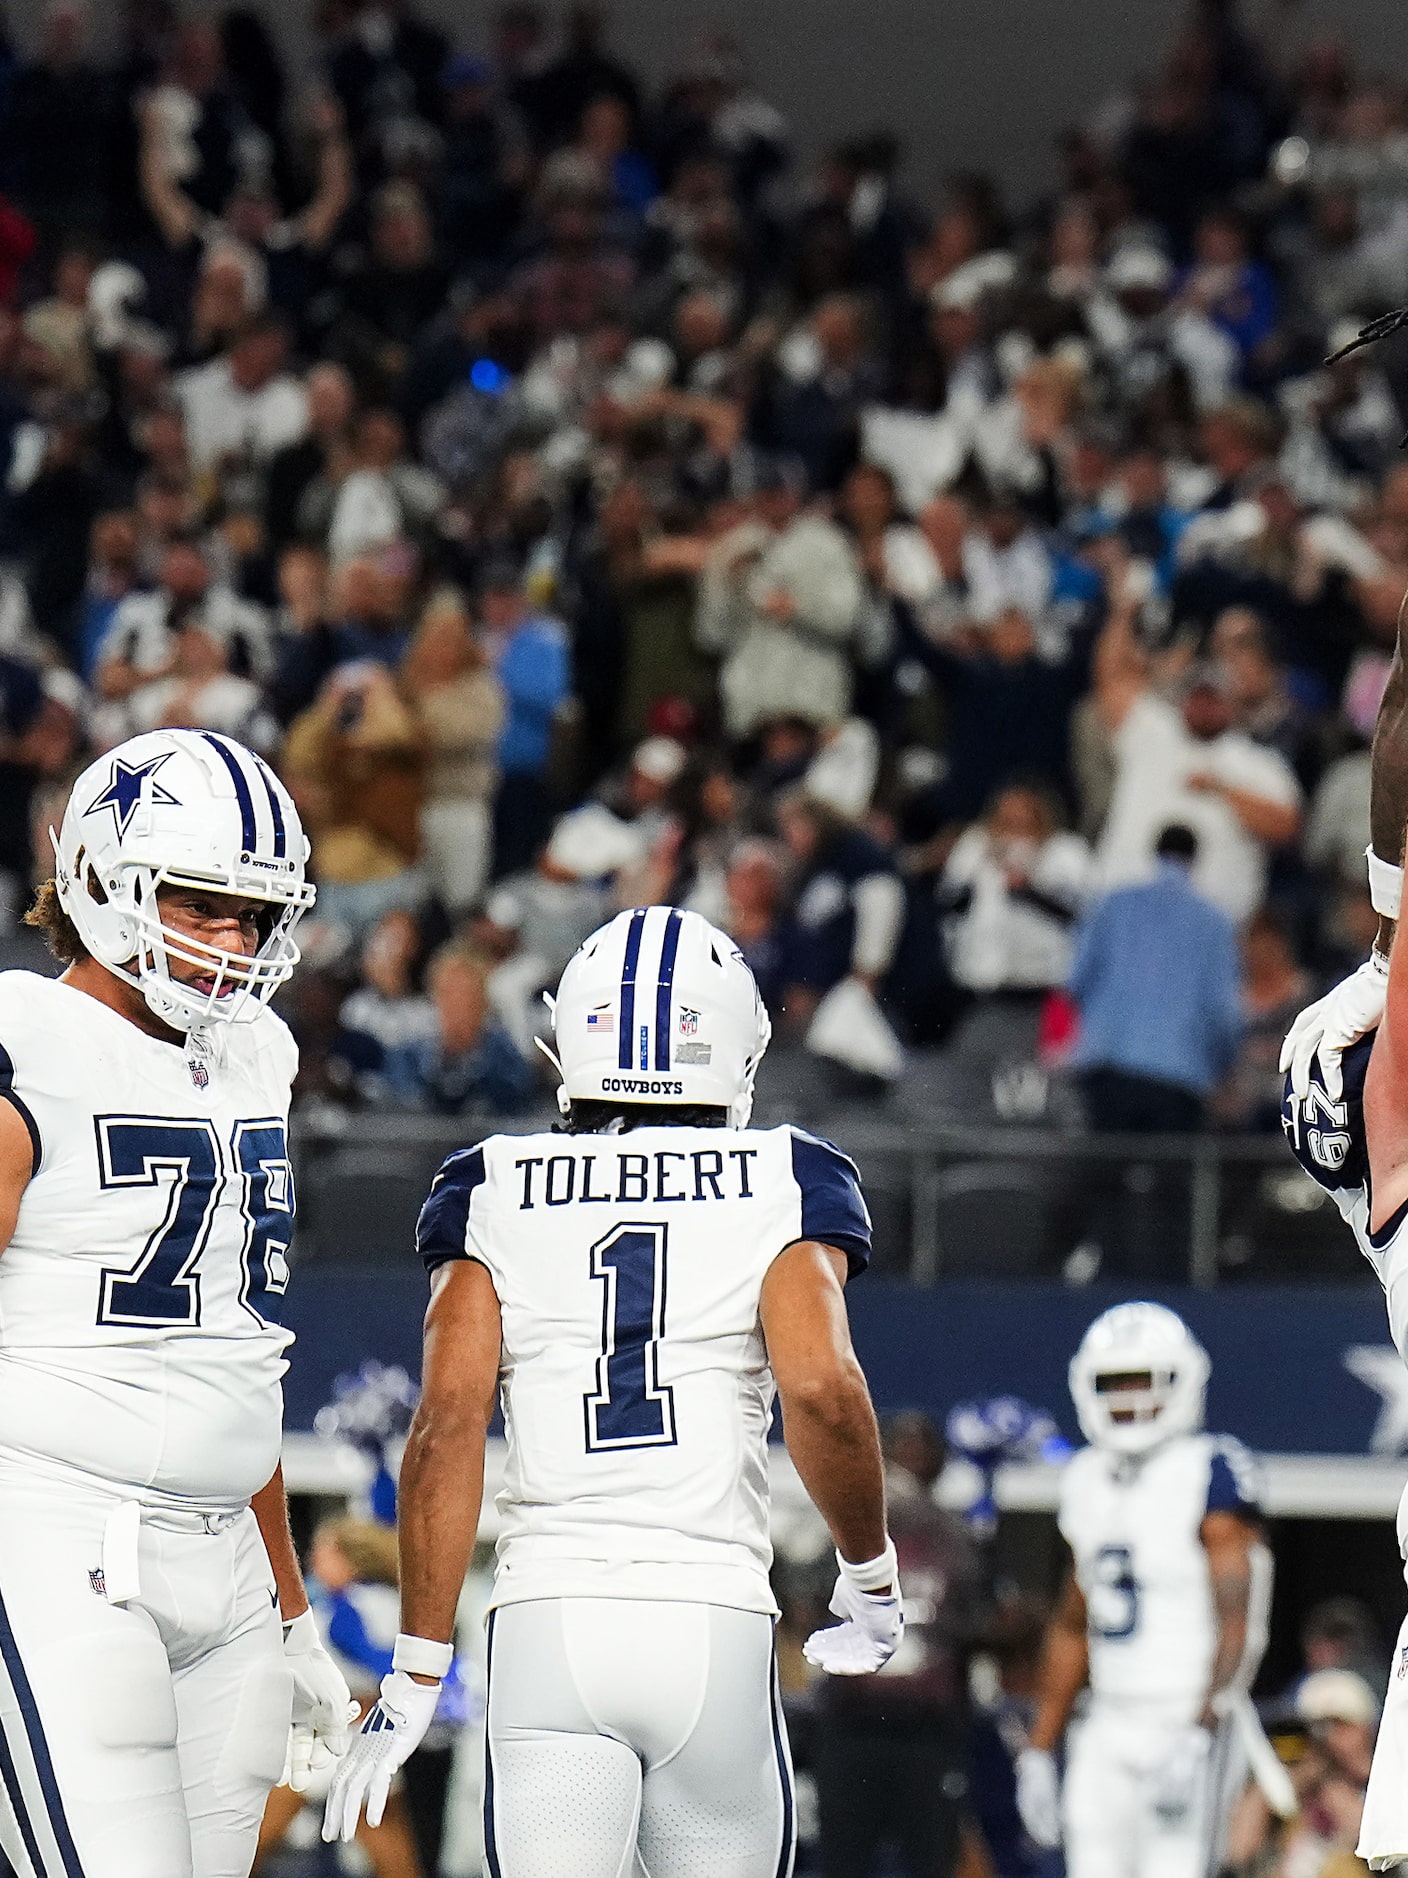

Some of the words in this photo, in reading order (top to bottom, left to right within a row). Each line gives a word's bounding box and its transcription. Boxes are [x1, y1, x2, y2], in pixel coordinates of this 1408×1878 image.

[602, 1078, 683, 1095] COWBOYS
[1303, 1080, 1352, 1171] 67
[515, 1150, 757, 1210] TOLBERT
[583, 1221, 678, 1454] 1
